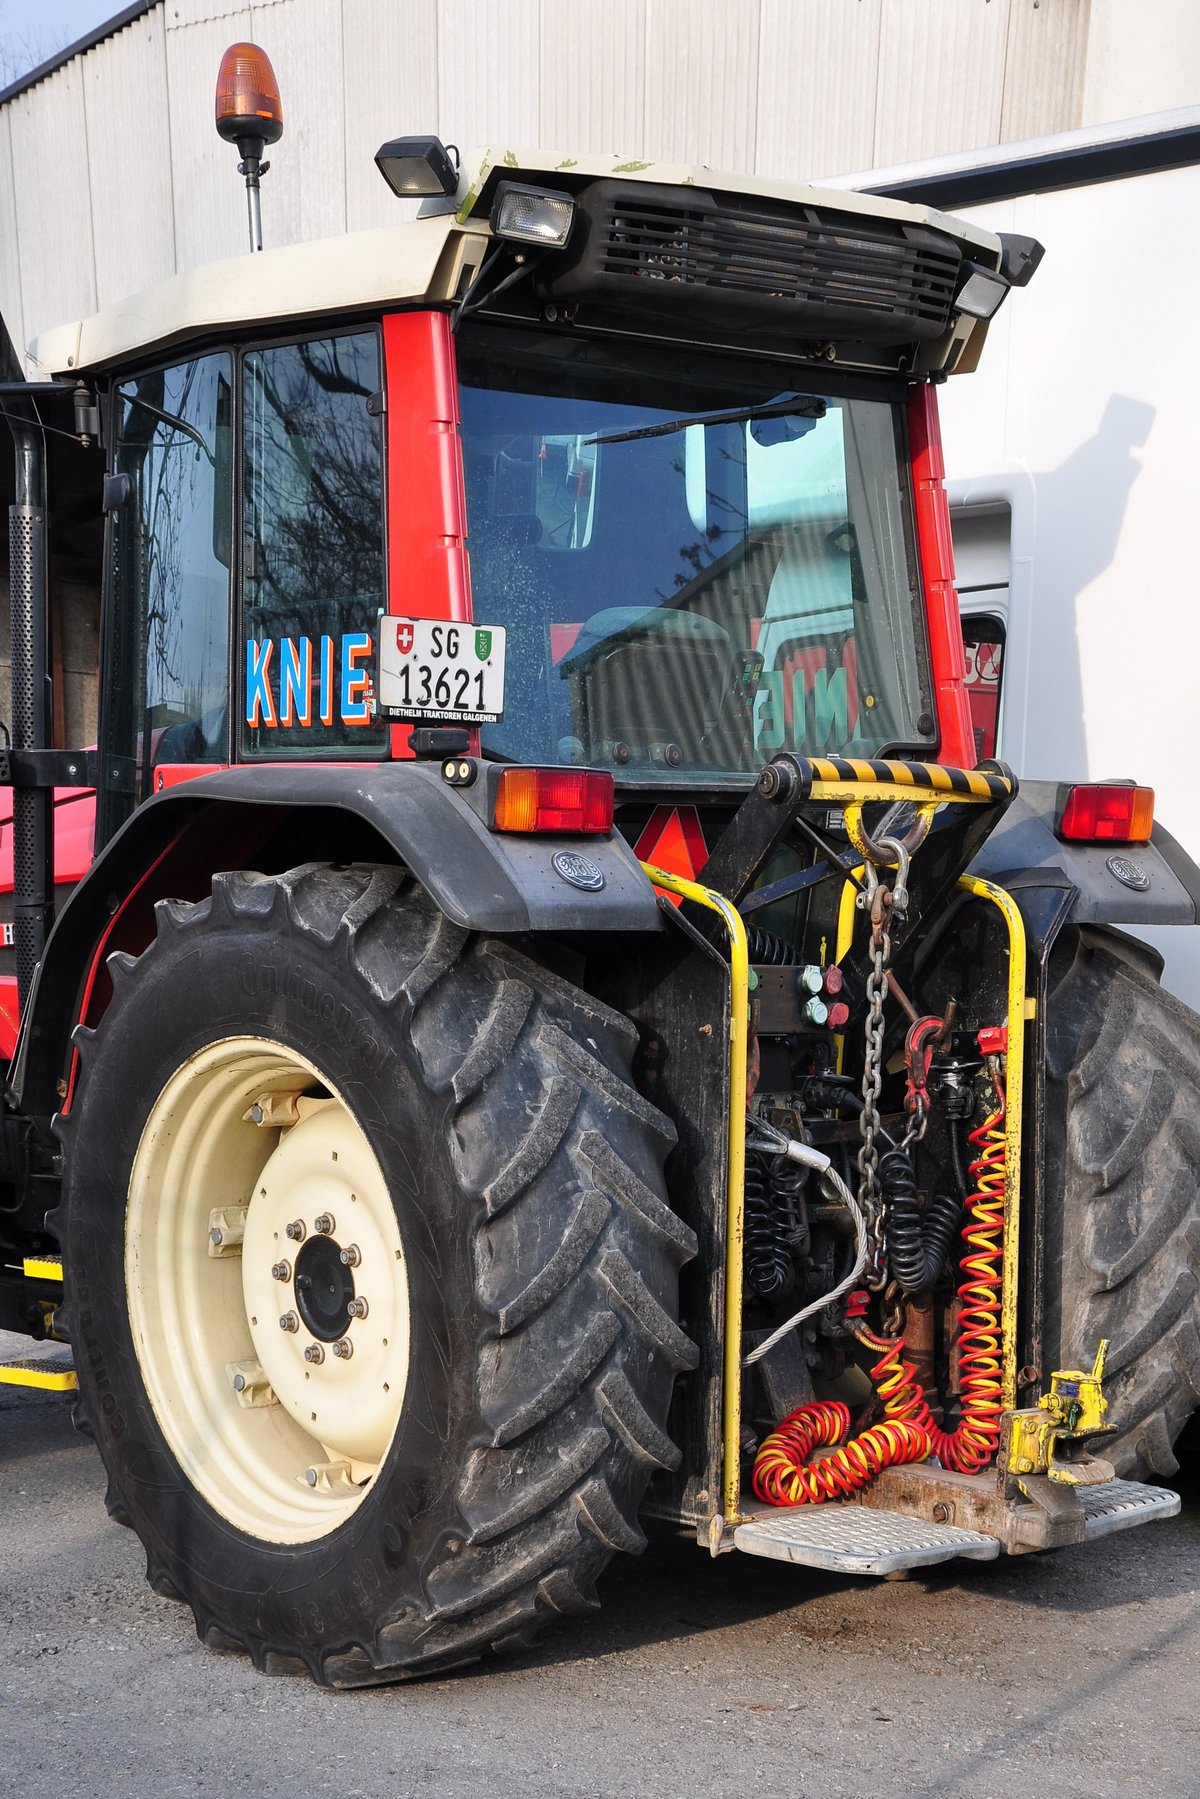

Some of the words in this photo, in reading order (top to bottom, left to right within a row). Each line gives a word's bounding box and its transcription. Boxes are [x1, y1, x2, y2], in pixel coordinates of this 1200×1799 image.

[430, 626, 460, 659] SG
[246, 633, 372, 727] KNIE
[399, 663, 486, 711] 13621
[389, 707, 422, 718] DIETHELM
[423, 710, 462, 720] TRAKTOREN
[463, 713, 497, 723] GALGENEN
[3, 922, 15, 945] H
